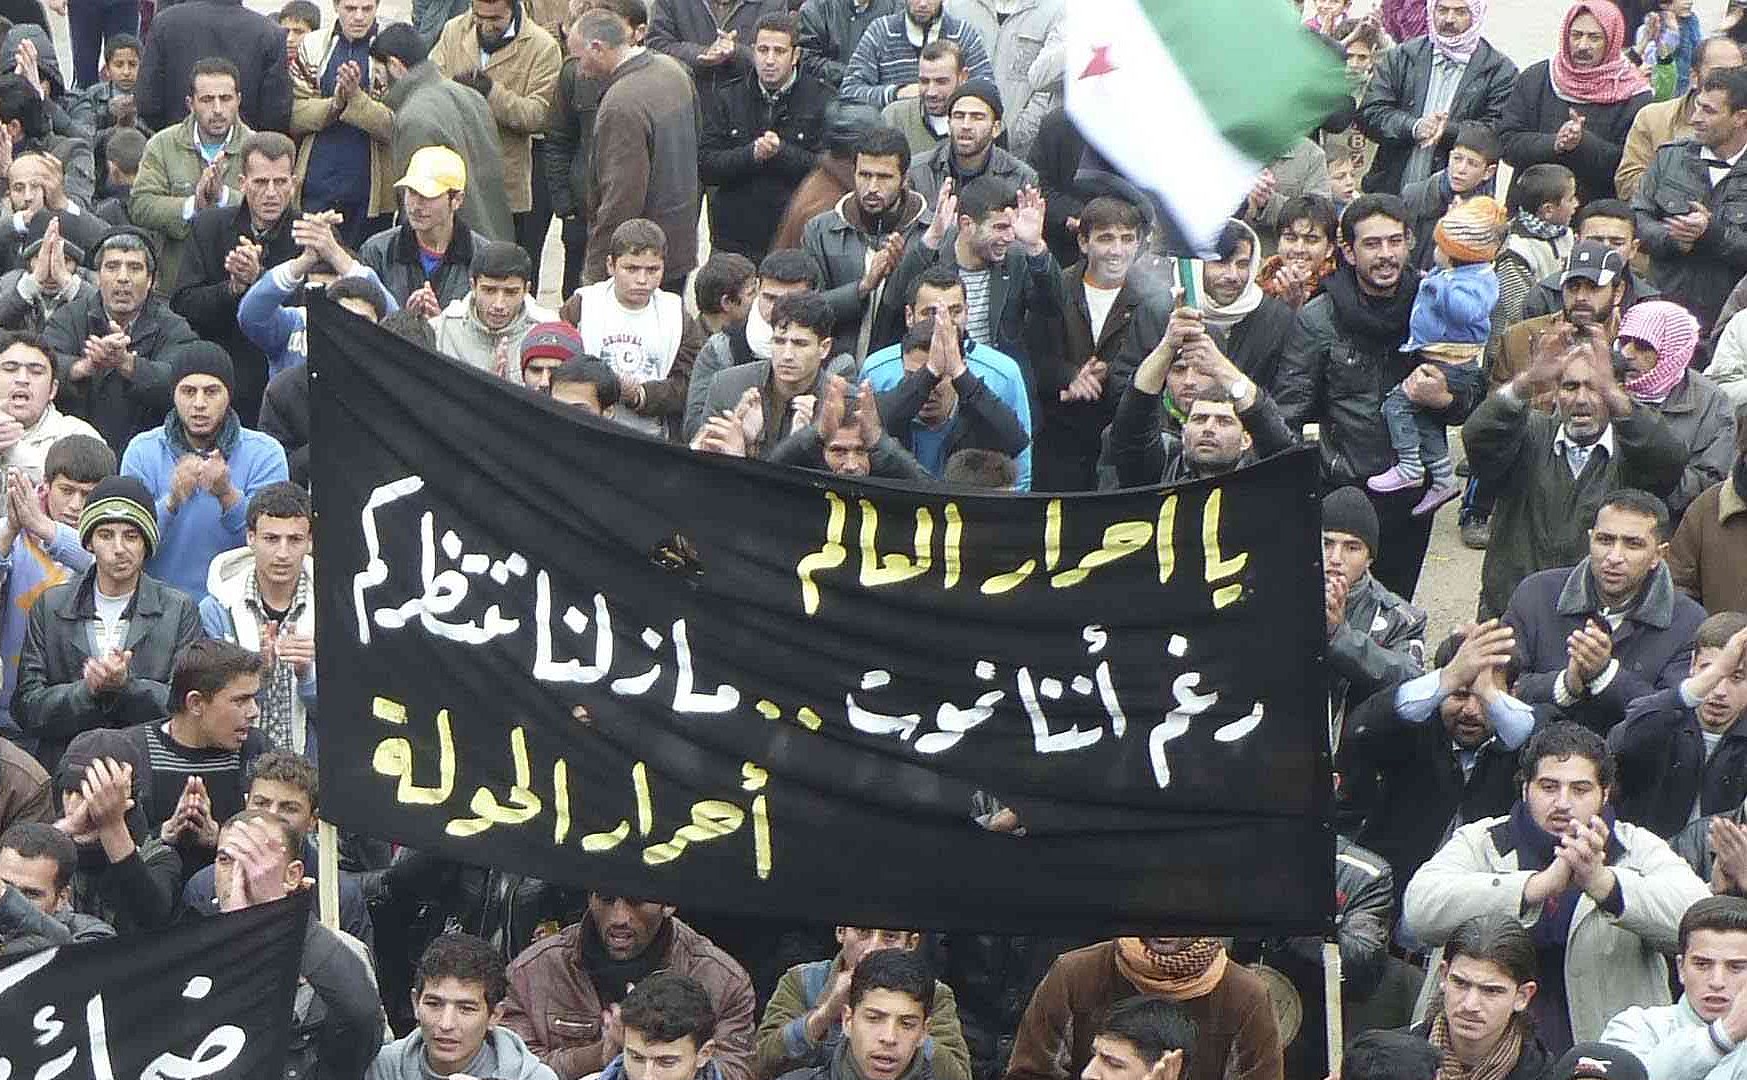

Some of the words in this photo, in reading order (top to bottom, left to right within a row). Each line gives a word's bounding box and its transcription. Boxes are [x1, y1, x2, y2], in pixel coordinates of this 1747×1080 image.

[796, 490, 964, 616] العالم
[979, 493, 1179, 595] احرار
[1202, 486, 1251, 610] يا
[371, 695, 571, 845] الحولة
[1149, 633, 1265, 789] رغم
[581, 760, 774, 881] أحرار
